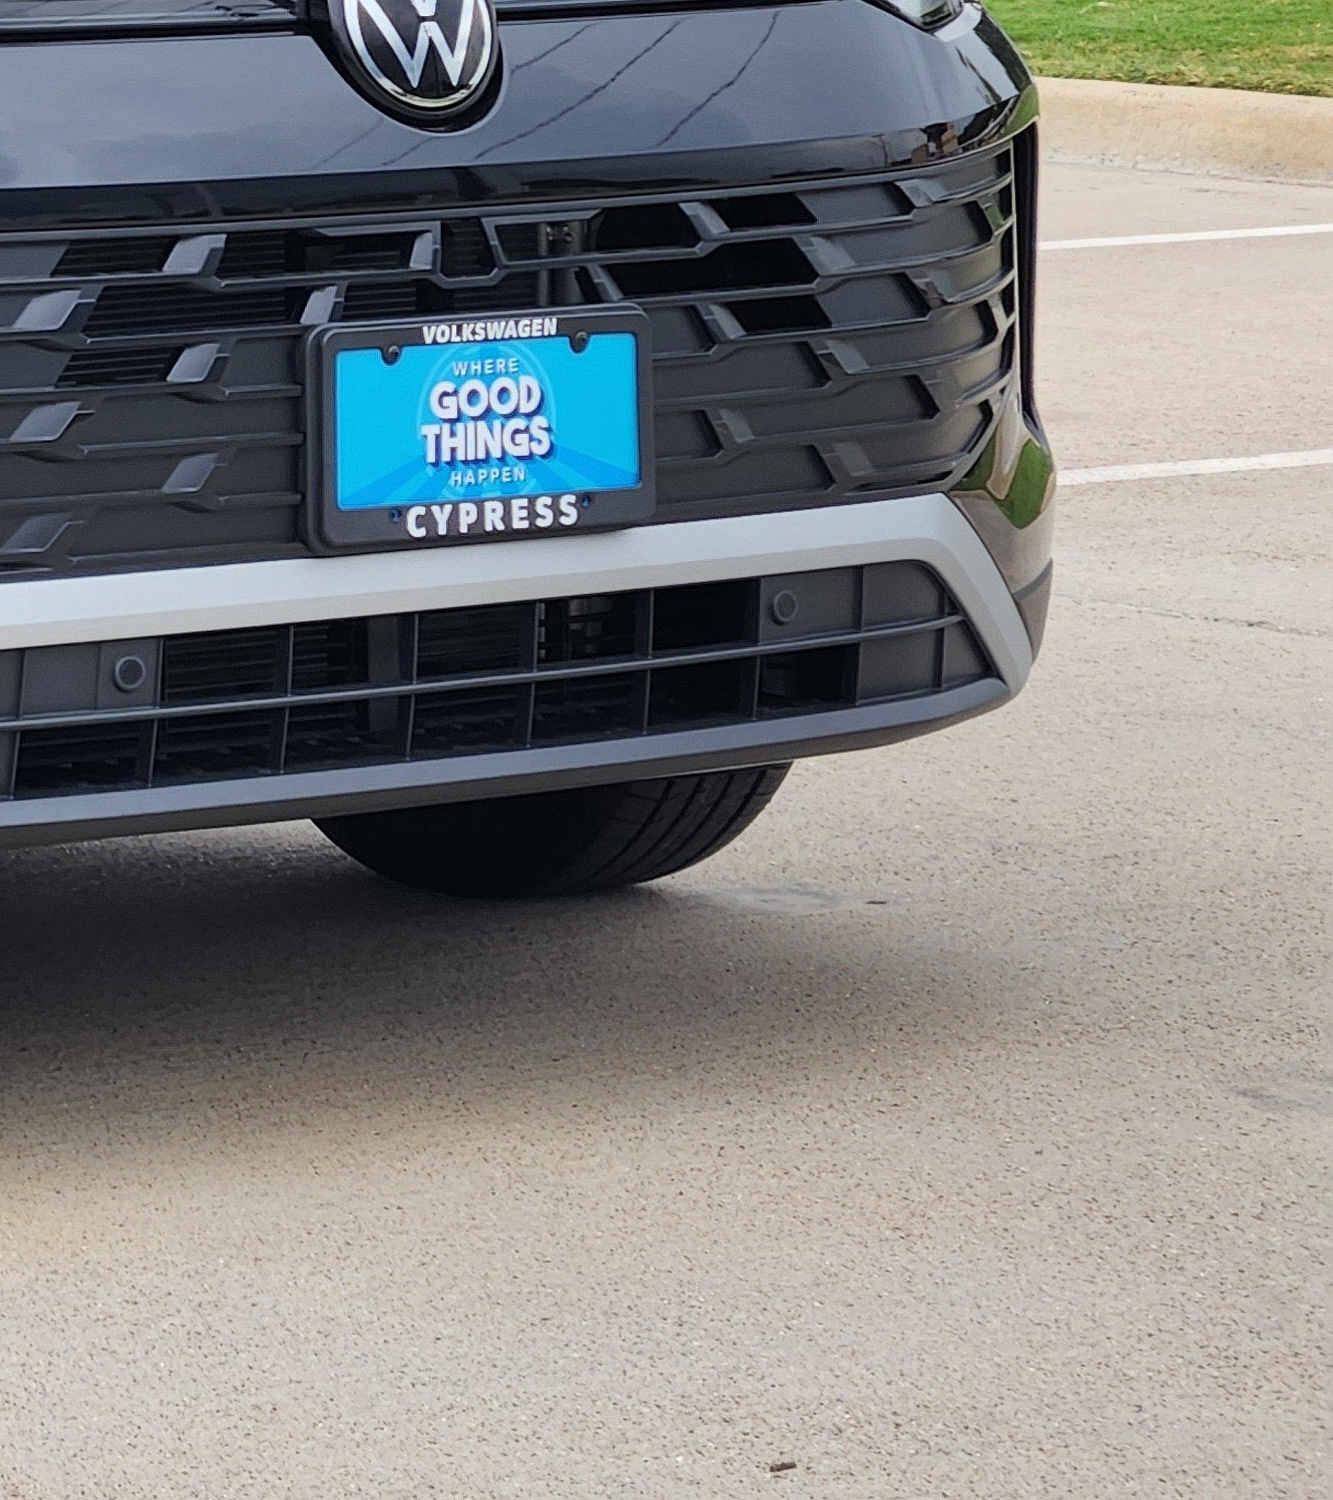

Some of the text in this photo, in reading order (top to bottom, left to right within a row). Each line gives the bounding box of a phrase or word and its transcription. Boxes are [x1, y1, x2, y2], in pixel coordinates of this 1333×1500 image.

[422, 317, 558, 345] VOLKSWAGEN
[452, 357, 520, 377] WHERE
[429, 374, 542, 420] GOOD
[421, 415, 554, 464] THINGS
[449, 466, 526, 488] HAPPEN
[405, 494, 580, 539] CYPRESS
